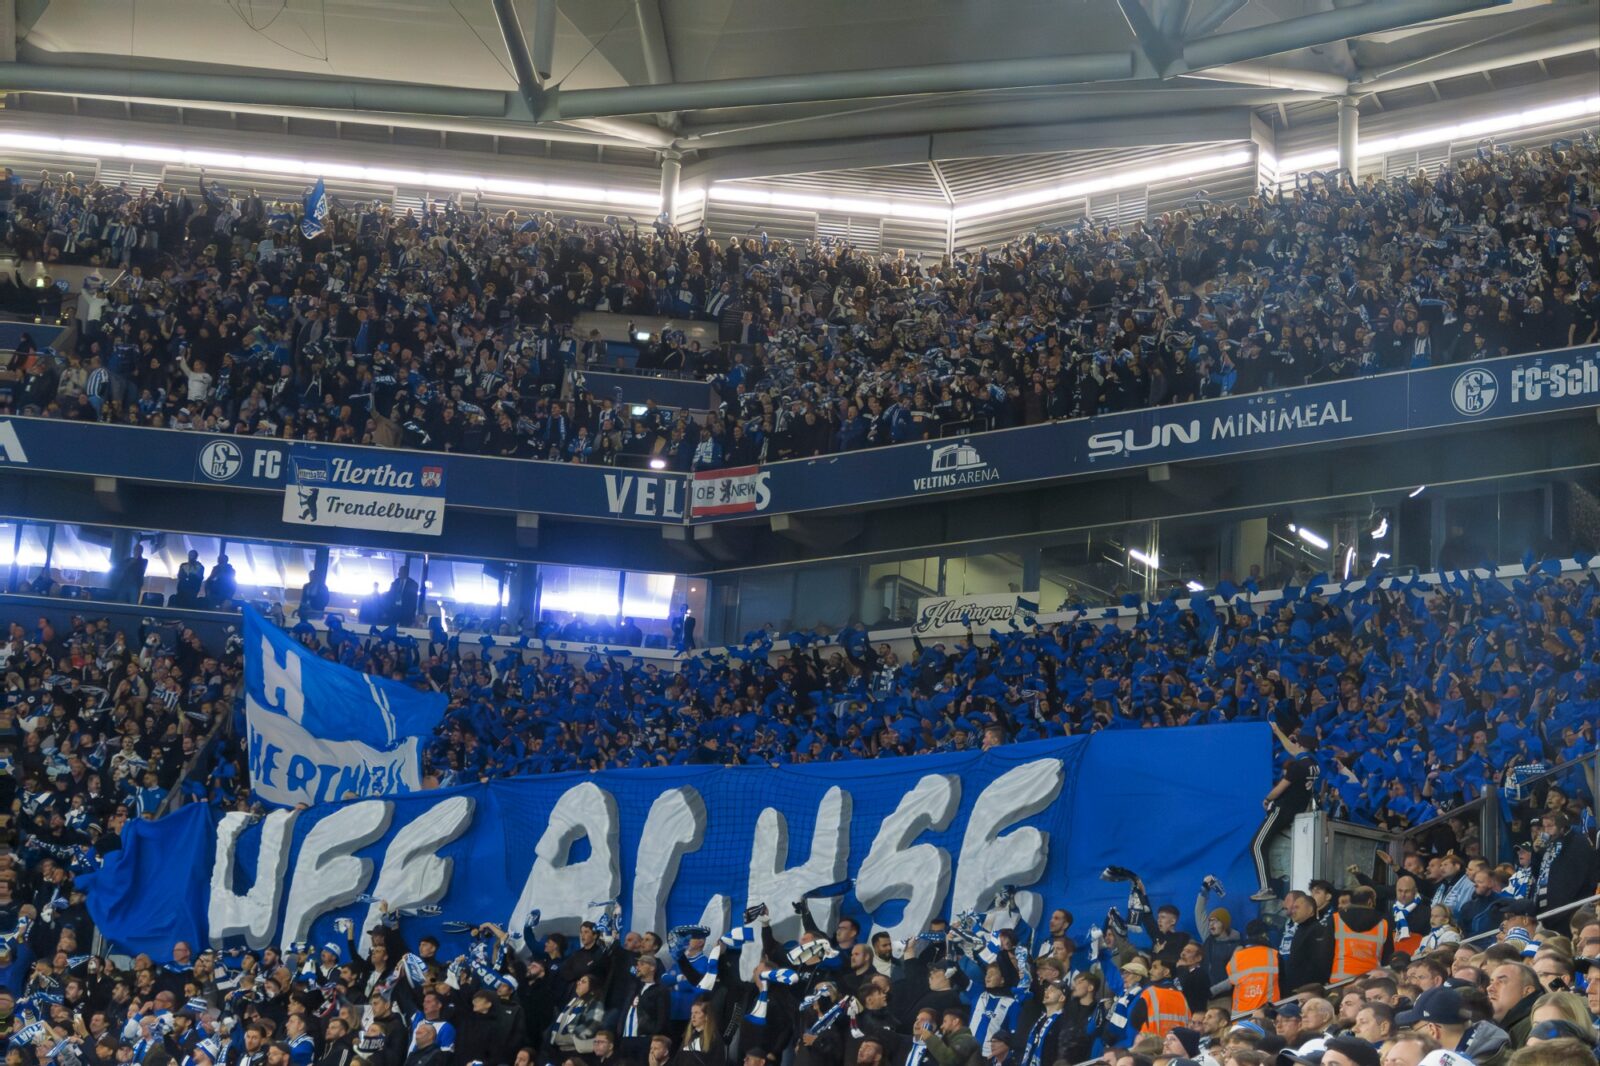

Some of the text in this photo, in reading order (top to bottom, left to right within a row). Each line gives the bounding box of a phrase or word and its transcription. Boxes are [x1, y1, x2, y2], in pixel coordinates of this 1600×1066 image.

[1088, 399, 1353, 458] SUN MINIMEAL
[252, 449, 282, 479] FC
[331, 457, 415, 489] Hertha
[913, 467, 1000, 491] VELTINS ARENA
[696, 481, 757, 500] OB NRW
[326, 496, 437, 529] Trendelburg
[261, 634, 305, 726] H
[207, 795, 476, 962] UFF
